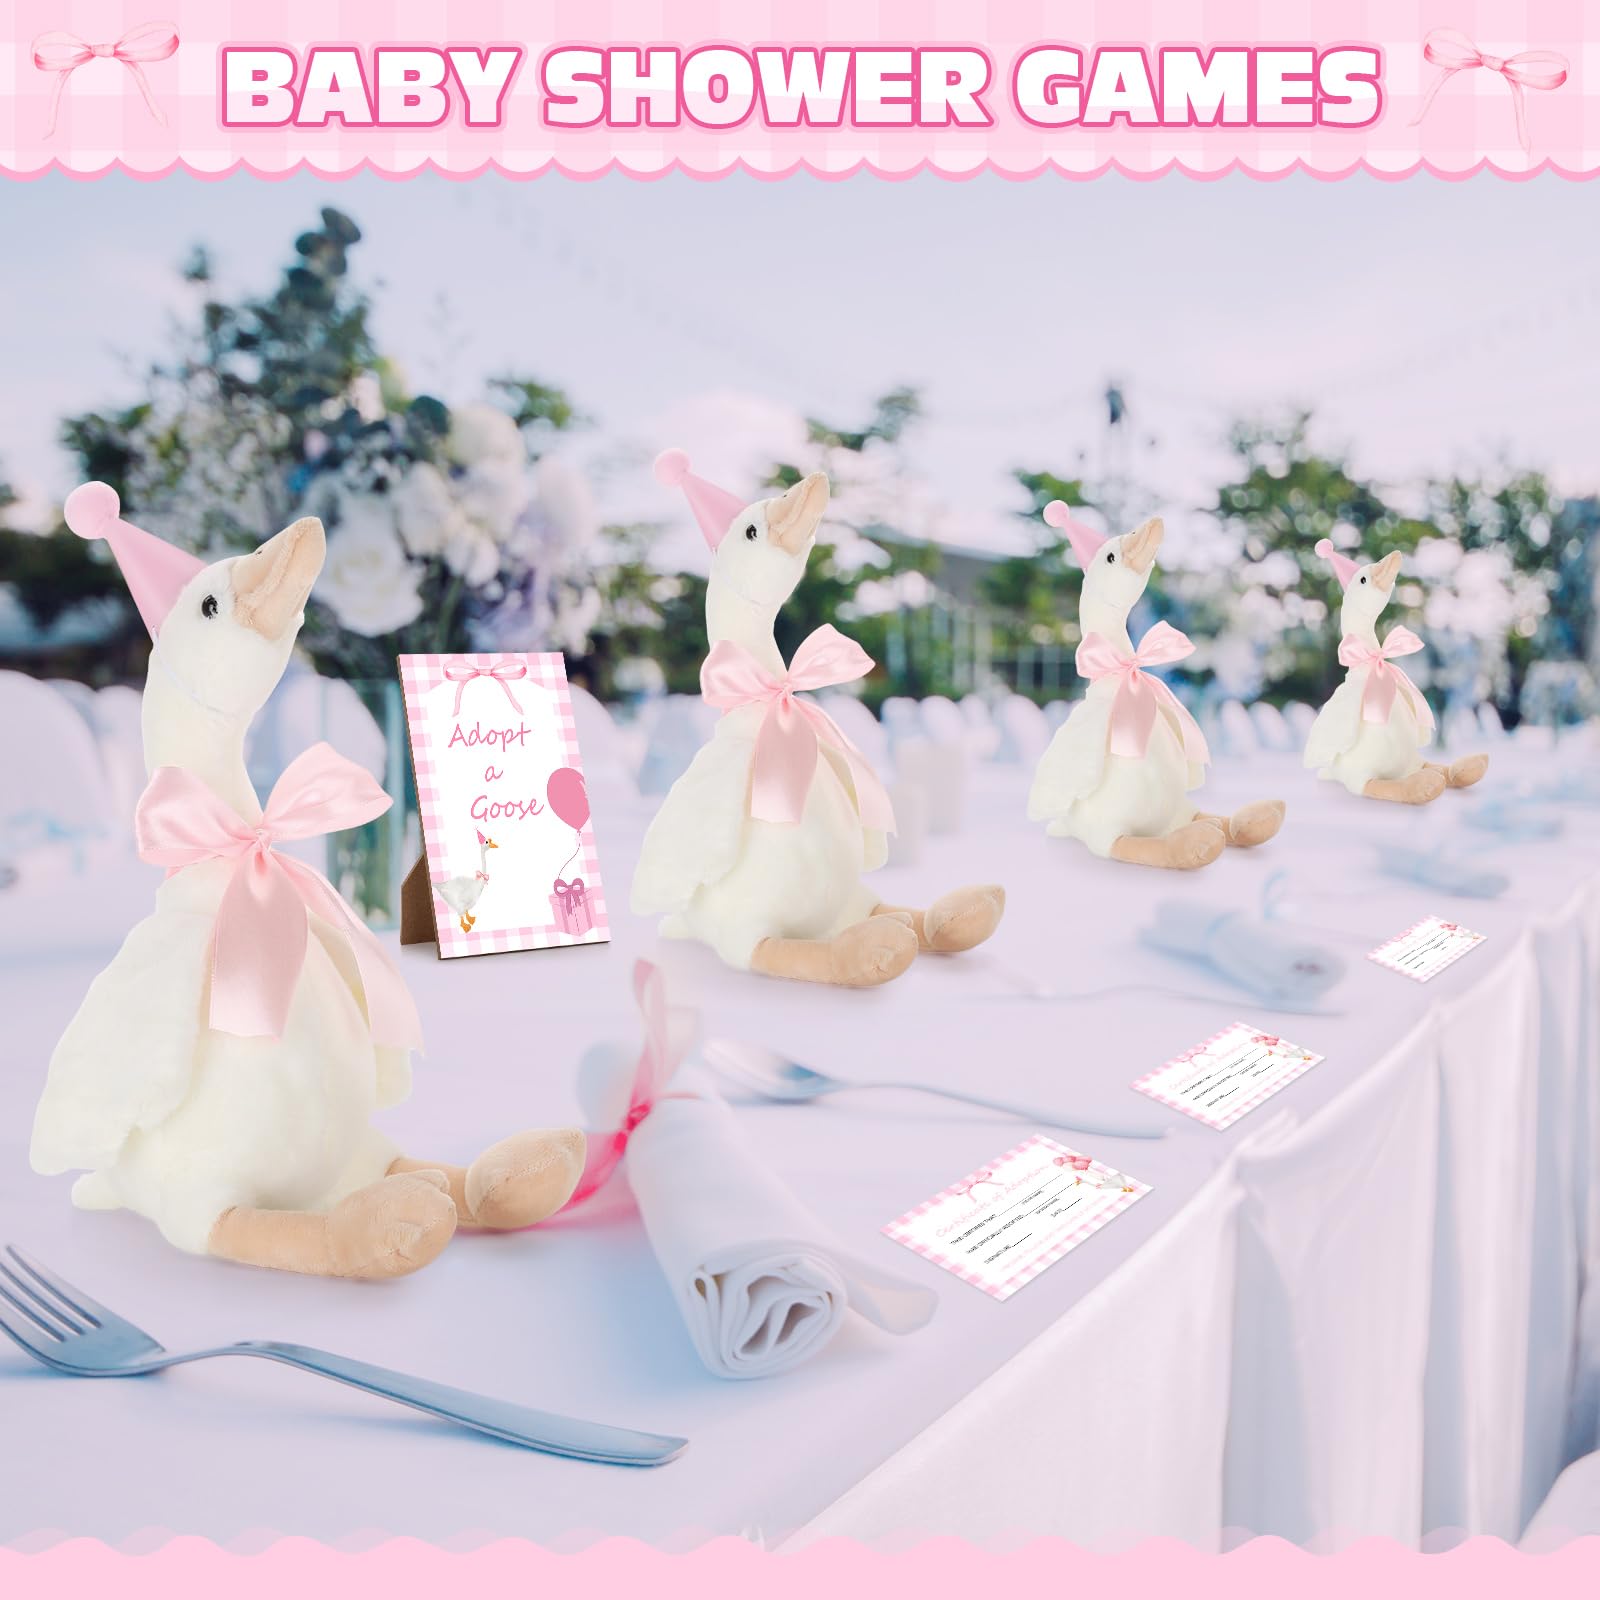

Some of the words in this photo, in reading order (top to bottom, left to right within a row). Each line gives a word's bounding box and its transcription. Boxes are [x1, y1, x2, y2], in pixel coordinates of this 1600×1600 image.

[448, 721, 532, 752] Adopt
[484, 765, 504, 783] a
[470, 794, 546, 822] Goose
